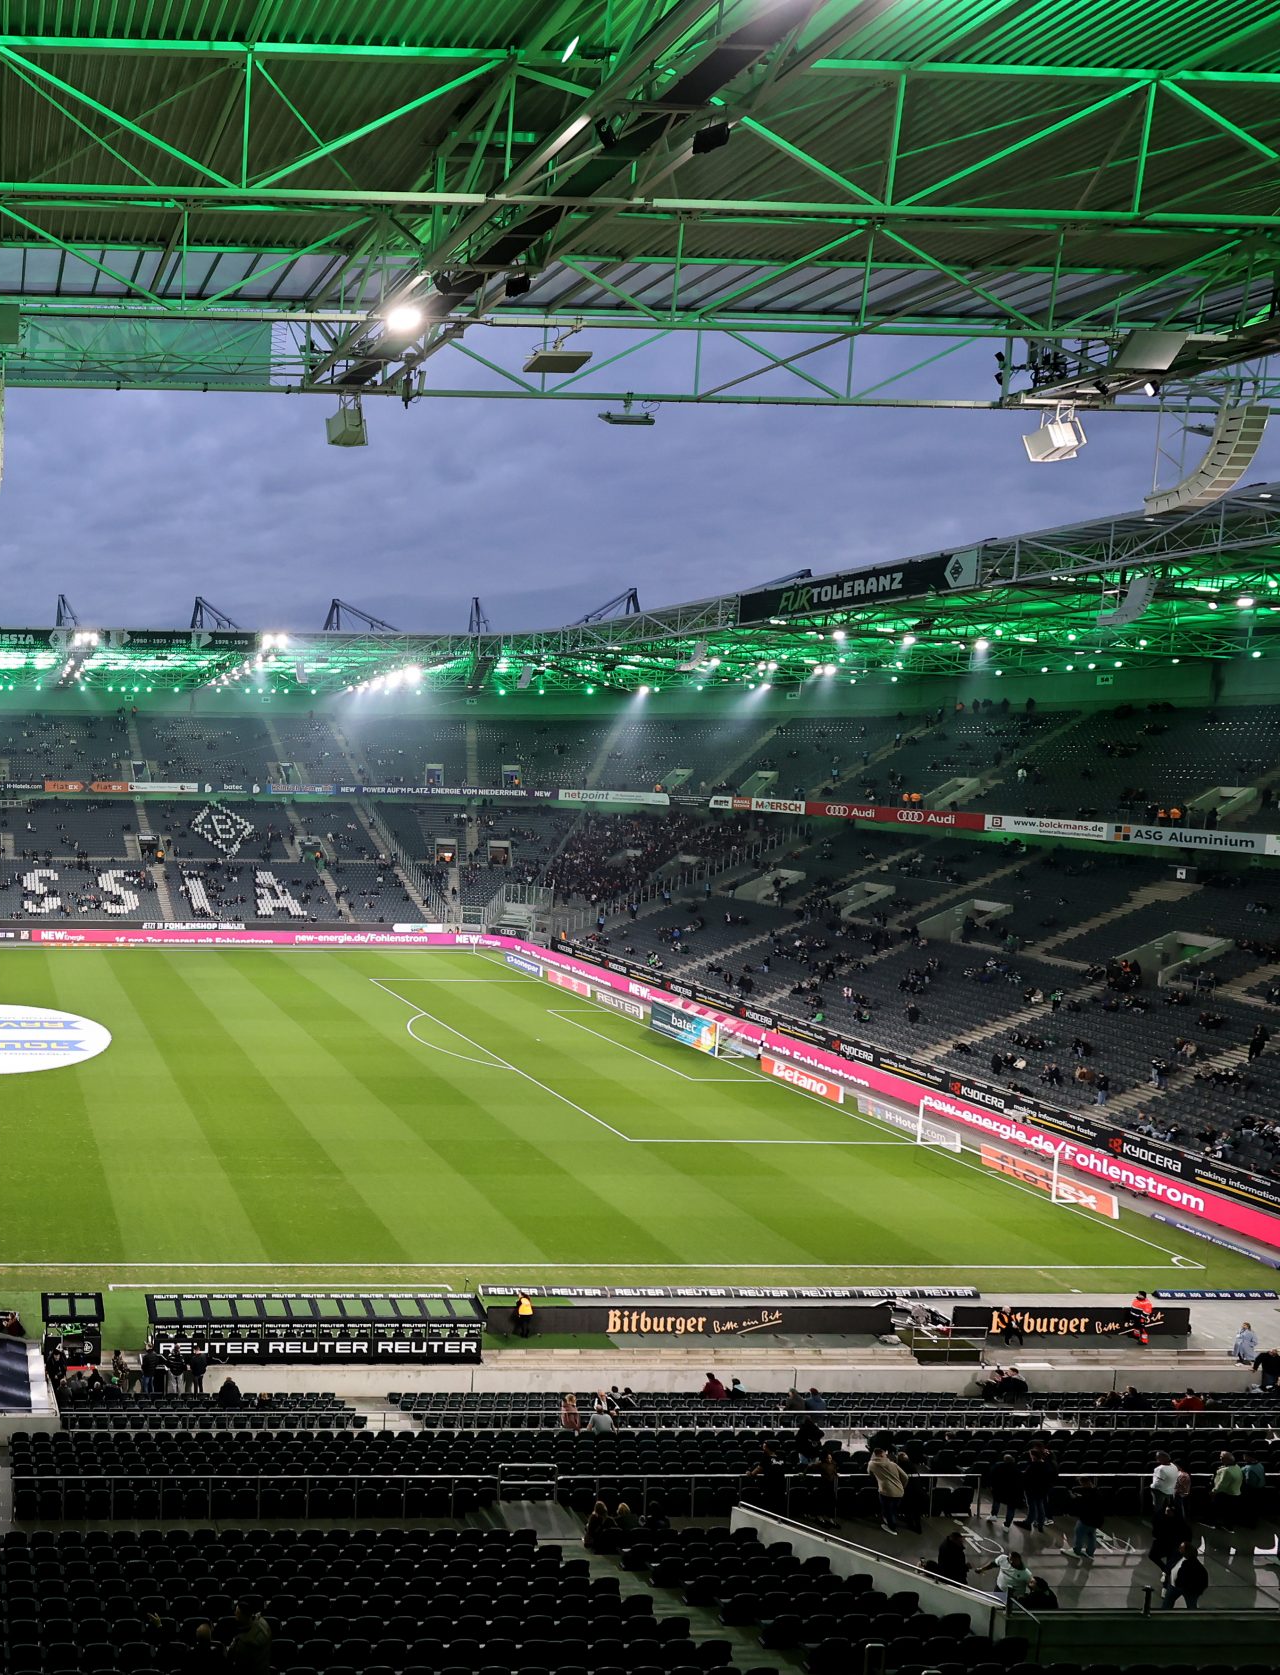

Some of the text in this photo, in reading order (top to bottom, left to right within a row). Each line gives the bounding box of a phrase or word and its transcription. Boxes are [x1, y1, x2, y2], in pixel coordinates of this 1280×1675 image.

[564, 791, 610, 801] netpoint
[851, 808, 875, 818] Audi
[927, 813, 955, 825] Audi
[1133, 829, 1255, 848] ASG Aluminium
[41, 931, 65, 940] NEW
[597, 991, 640, 1017] REUTER
[671, 1013, 696, 1034] batec
[745, 1010, 772, 1026] KYOCERA
[839, 1043, 874, 1062] KYOCERA
[773, 1063, 827, 1096] Betano
[960, 1086, 1005, 1109] KYOCERA
[1038, 1112, 1076, 1130] information
[1076, 1126, 1098, 1138] faster
[1123, 1142, 1182, 1173] KYOCERA
[1194, 1168, 1280, 1203] making information
[552, 1287, 602, 1297] REUTER
[615, 1288, 665, 1297] REUTER
[677, 1288, 726, 1297] REUTER
[740, 1288, 789, 1297] REUTER
[801, 1288, 851, 1297] REUTER
[863, 1288, 912, 1297] REUTER
[924, 1289, 973, 1298] REUTER
[606, 1309, 708, 1336] Bitburger
[760, 1310, 783, 1325] Bit
[269, 1342, 369, 1354] REUTER
[378, 1341, 477, 1353] REUTER
